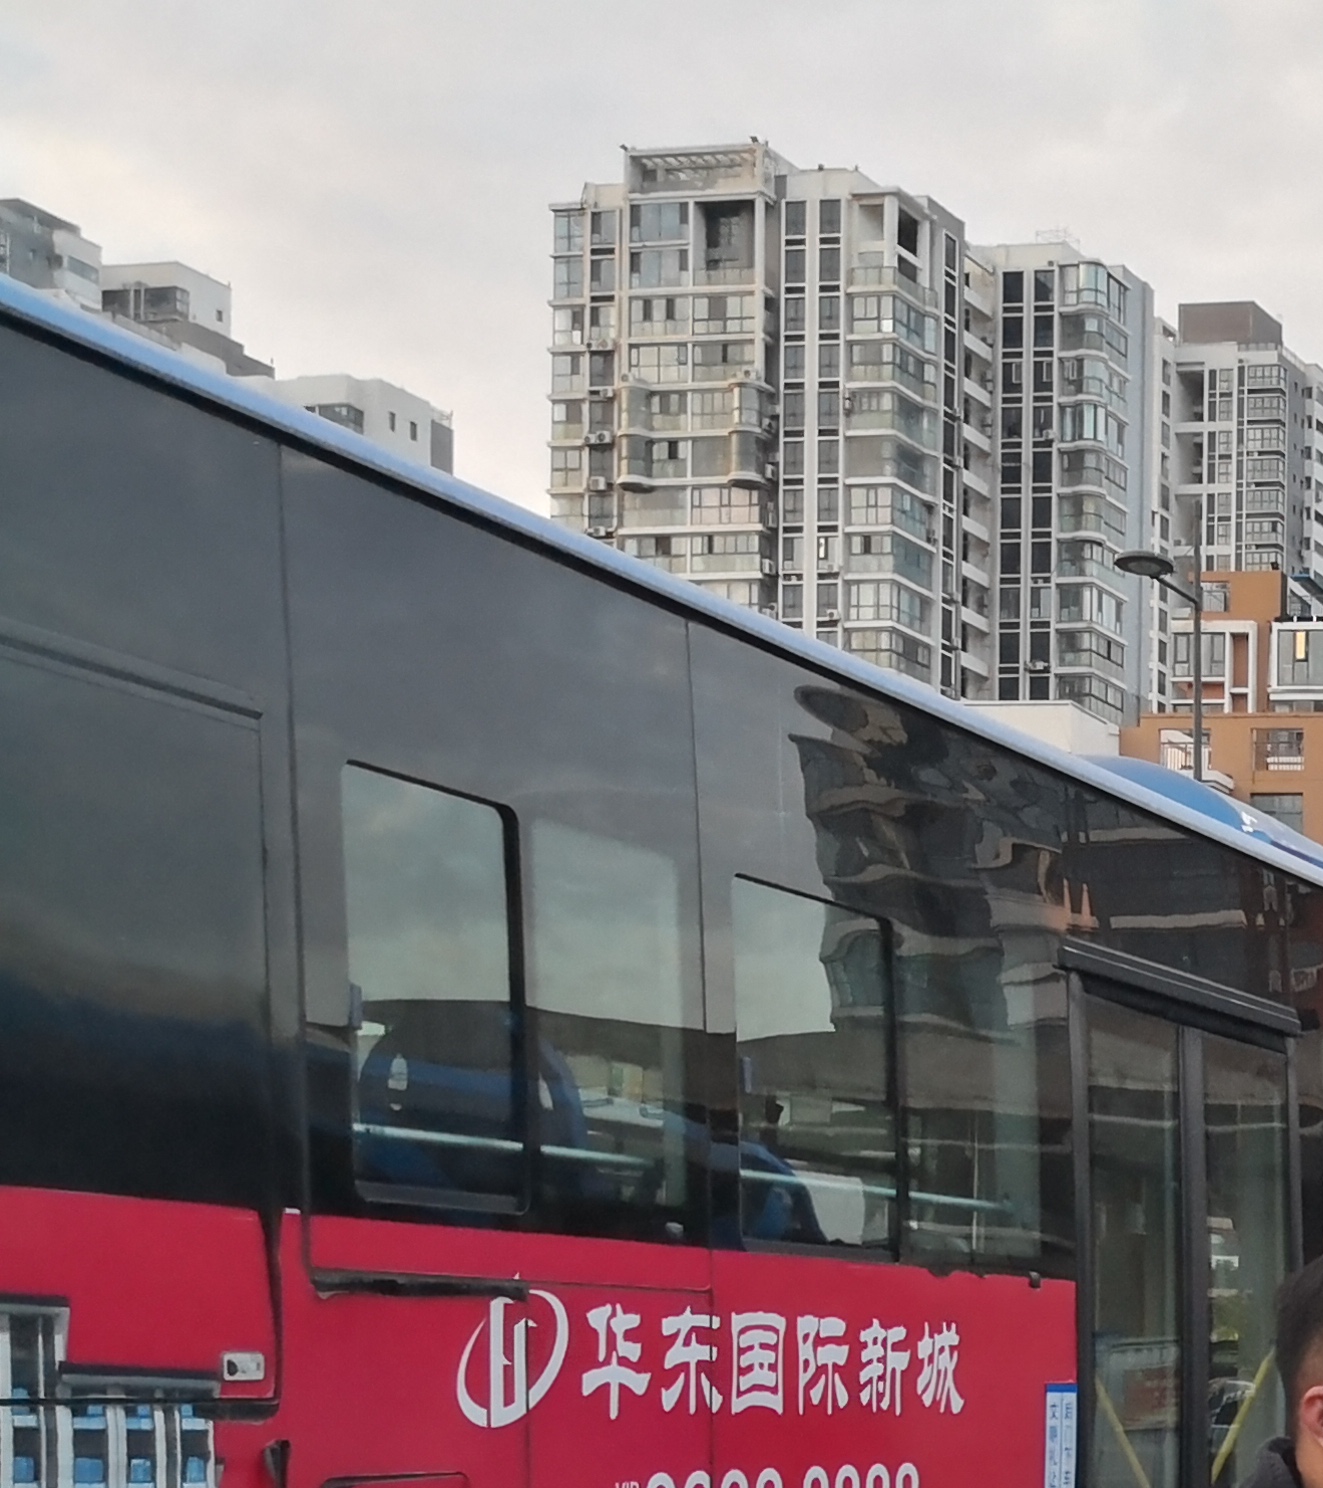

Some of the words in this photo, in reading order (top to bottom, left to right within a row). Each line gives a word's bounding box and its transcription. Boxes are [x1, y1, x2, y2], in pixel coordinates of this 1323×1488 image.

[581, 1303, 965, 1420] 华东国际新城
